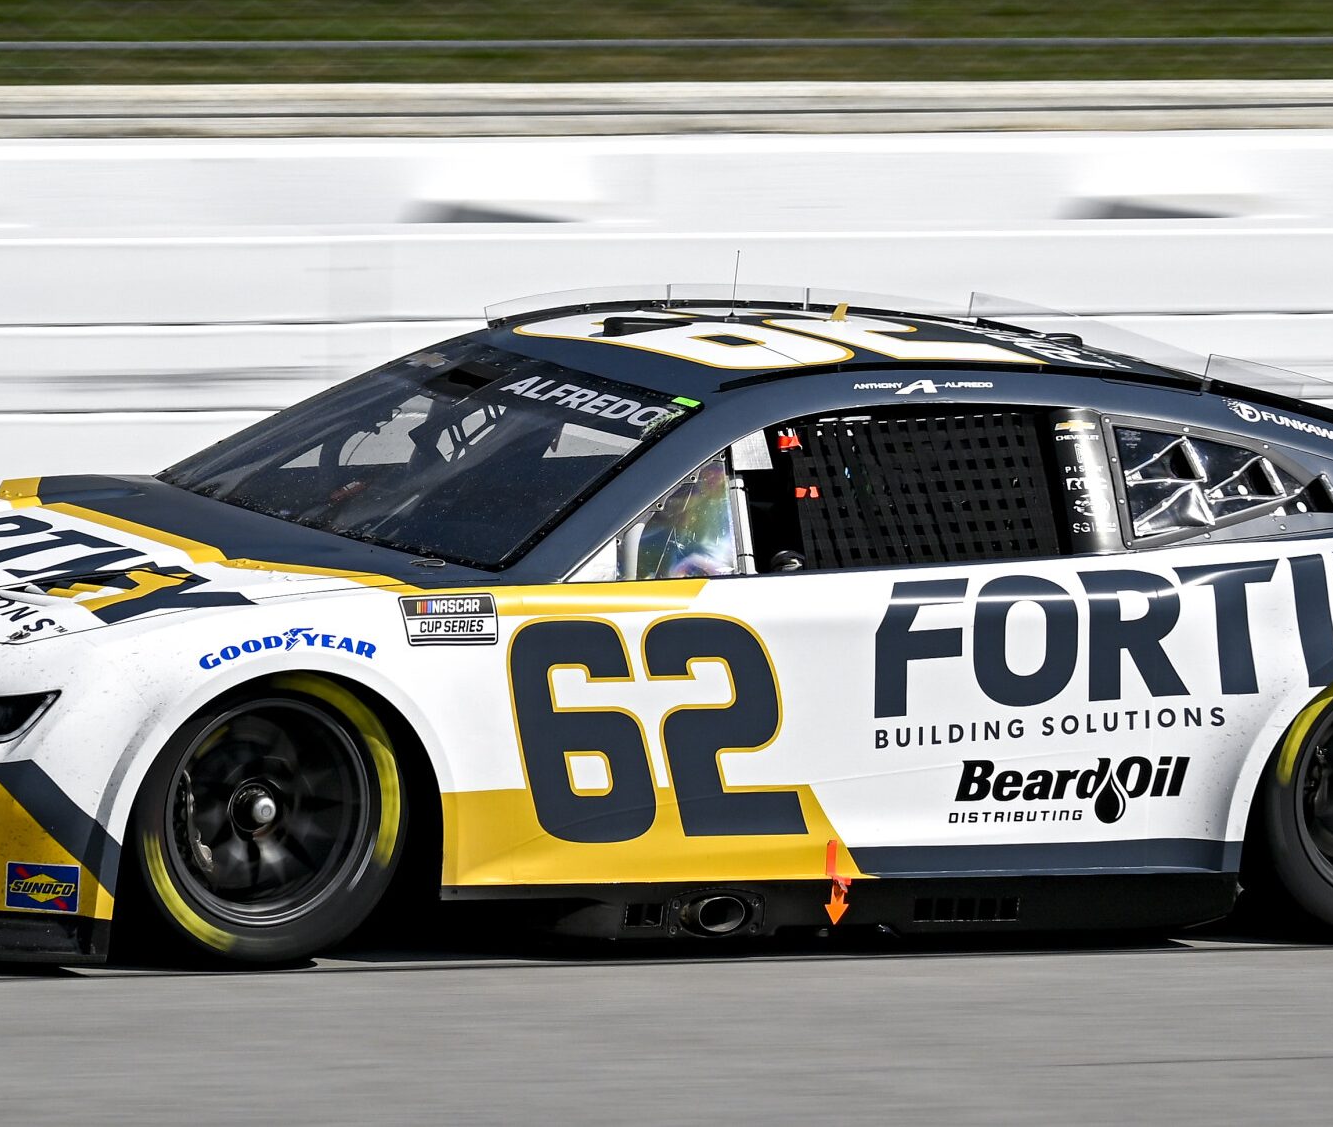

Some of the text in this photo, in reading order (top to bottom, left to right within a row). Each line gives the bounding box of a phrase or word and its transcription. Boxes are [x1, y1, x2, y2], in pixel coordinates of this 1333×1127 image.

[853, 382, 903, 390] ANTHONY
[499, 375, 670, 427] ALFREDO
[432, 599, 480, 614] NASCAR
[419, 619, 484, 633] CUP SERIES
[506, 612, 809, 844] 62
[874, 706, 1226, 749] BUILDING SOLUTIONS
[948, 810, 1083, 824] DISTRIBUTING
[10, 879, 75, 897] SUNOCO
